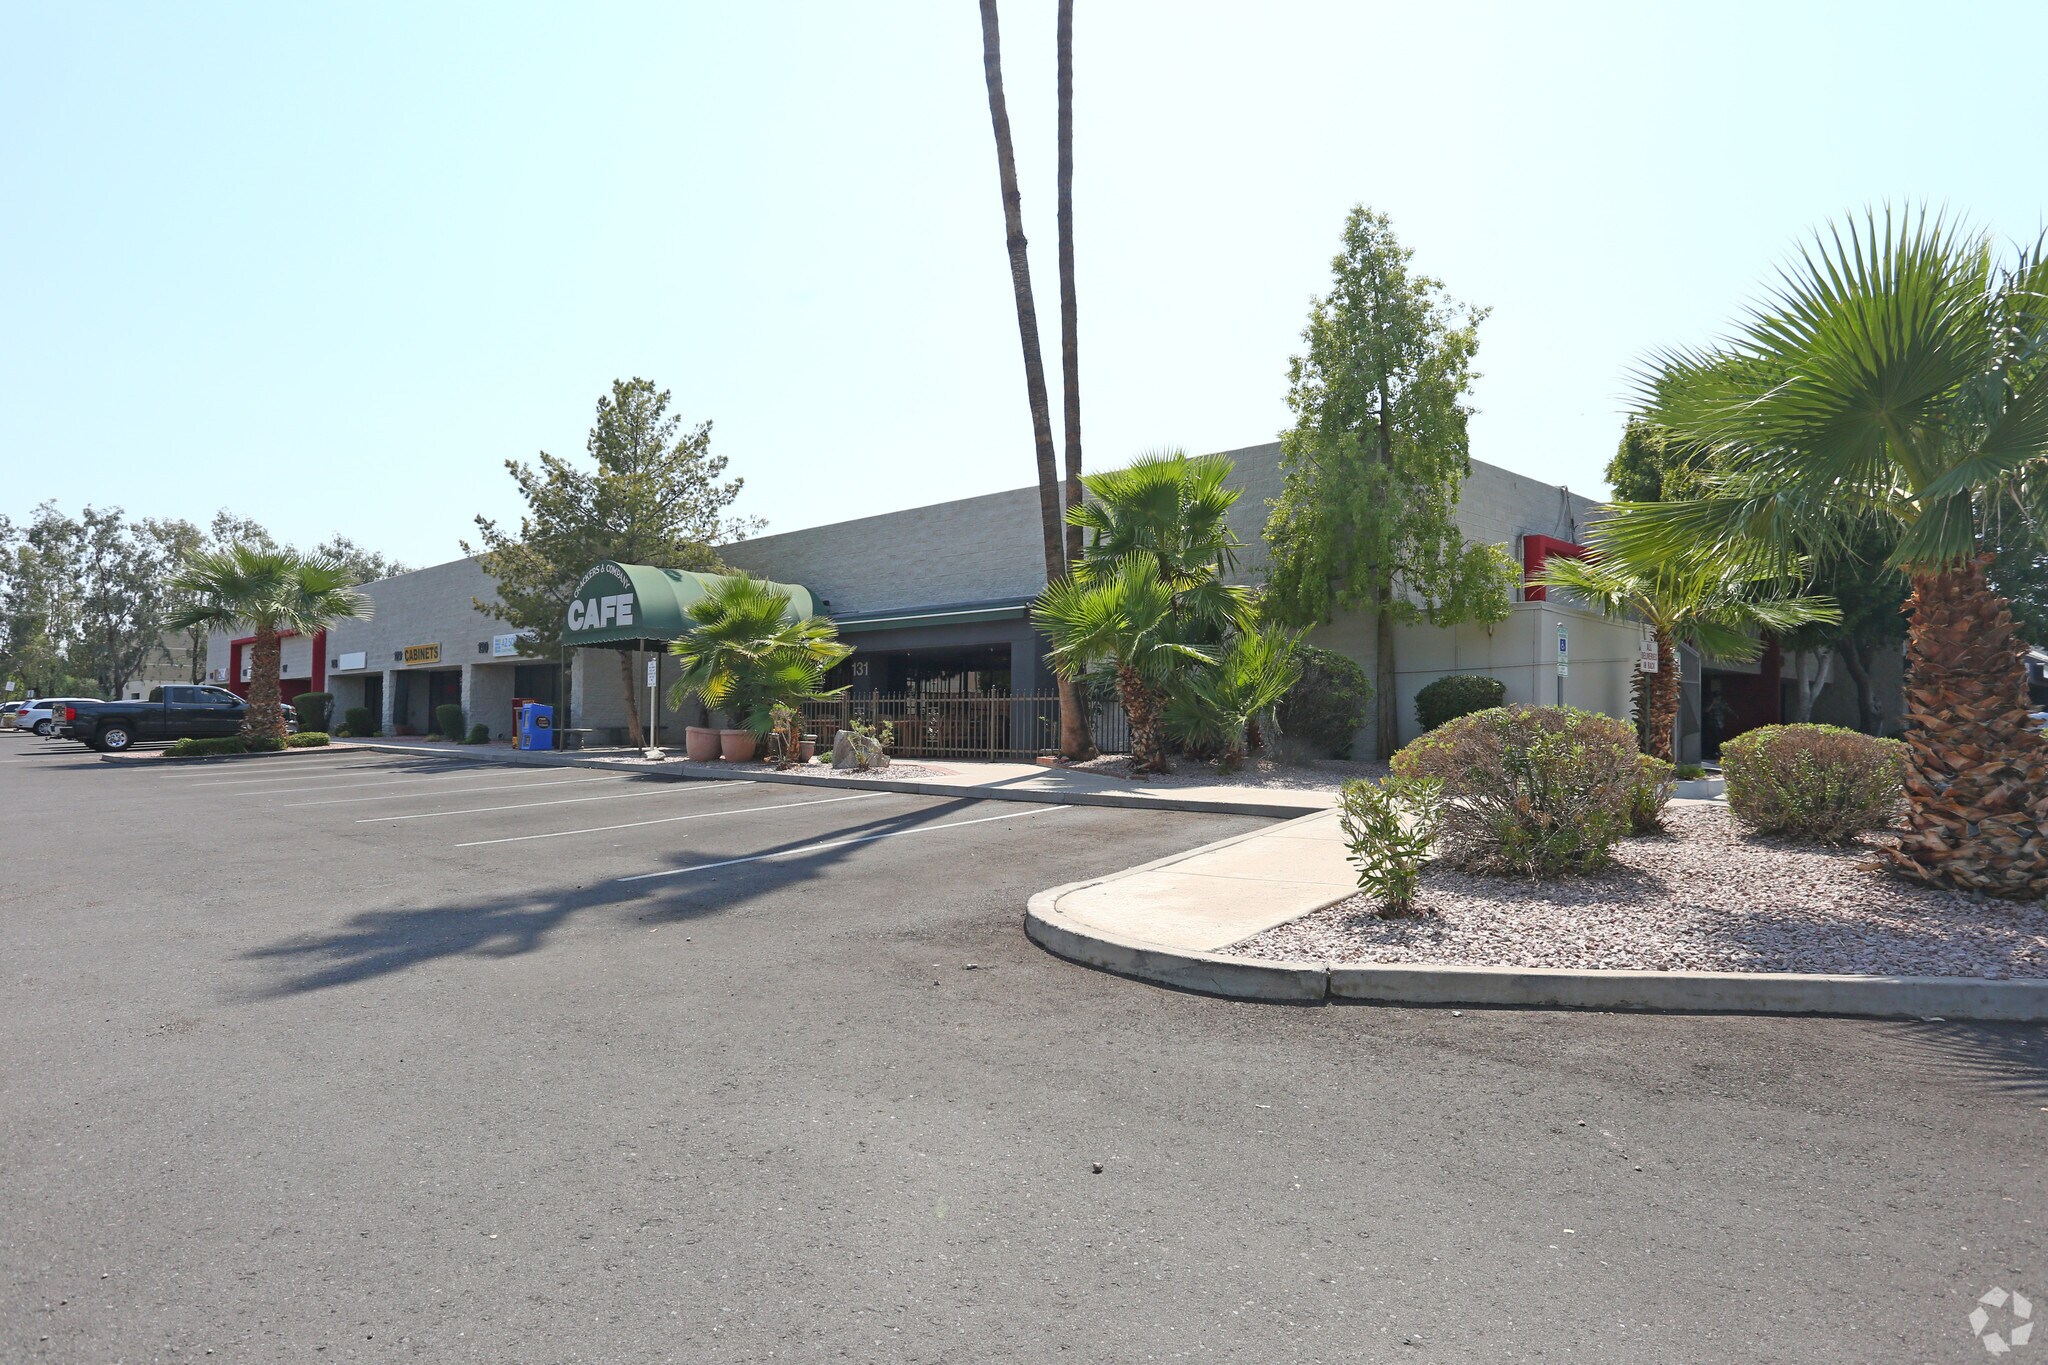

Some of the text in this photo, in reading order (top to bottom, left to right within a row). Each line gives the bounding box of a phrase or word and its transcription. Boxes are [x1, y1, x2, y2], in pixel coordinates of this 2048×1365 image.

[573, 563, 631, 598] CRACKERS & COMPANY
[567, 592, 634, 631] CAFE
[404, 646, 439, 662] CABINETS
[851, 661, 869, 676] 131
